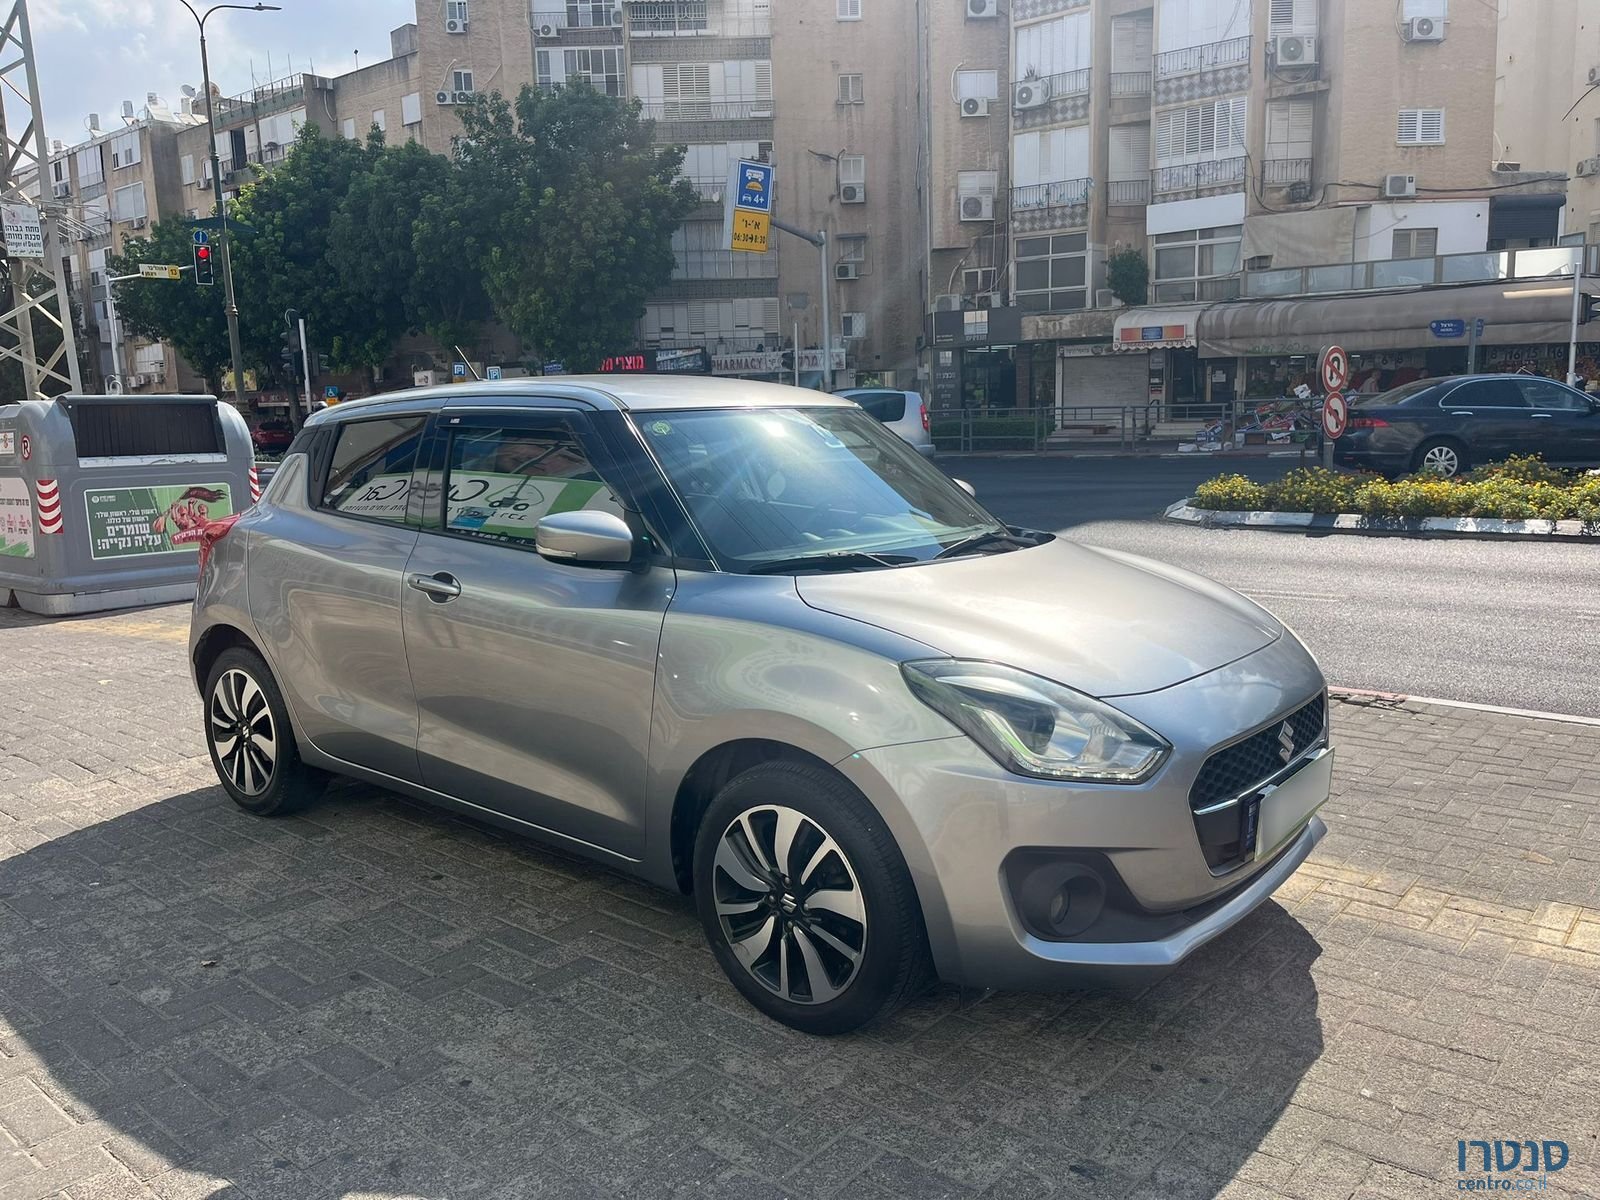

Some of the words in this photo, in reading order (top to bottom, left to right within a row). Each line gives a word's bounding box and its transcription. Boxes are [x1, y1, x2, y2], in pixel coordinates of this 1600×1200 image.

[615, 355, 645, 370] מוצרי
[106, 523, 150, 537] שומרים
[97, 536, 132, 550] נקייה!
[134, 533, 162, 547] עליה
